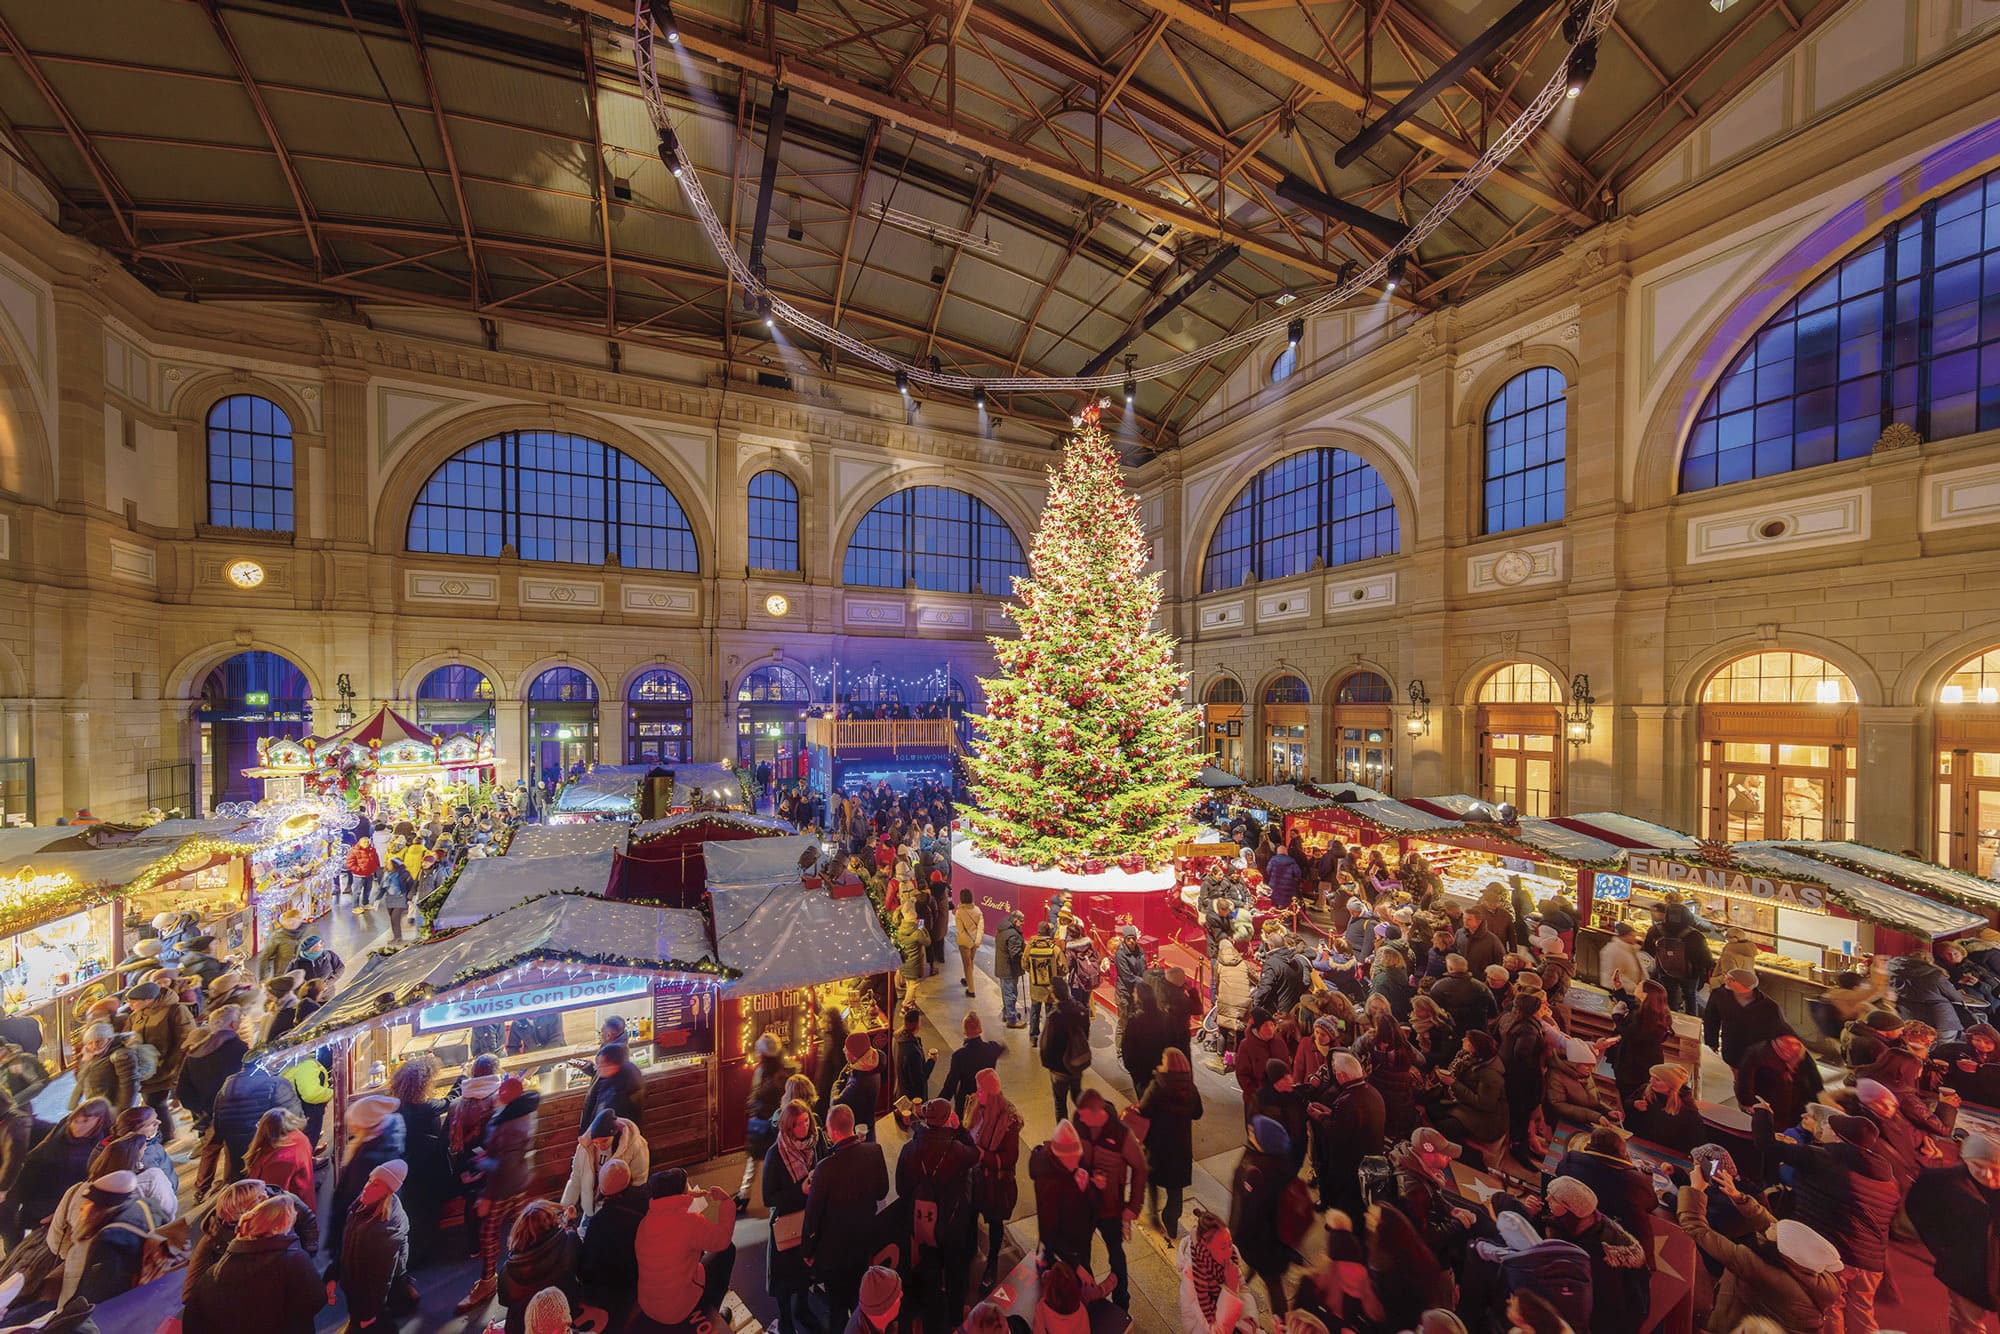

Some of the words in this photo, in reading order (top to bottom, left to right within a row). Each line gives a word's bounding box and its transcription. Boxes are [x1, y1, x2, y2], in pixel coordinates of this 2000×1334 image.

[1630, 856, 1822, 909] EMPANADAS
[981, 895, 1004, 910] Lindt
[459, 998, 513, 1017] Swiss
[519, 992, 563, 1006] Corn
[570, 982, 616, 999] Dogs
[782, 989, 800, 1007] Gin
